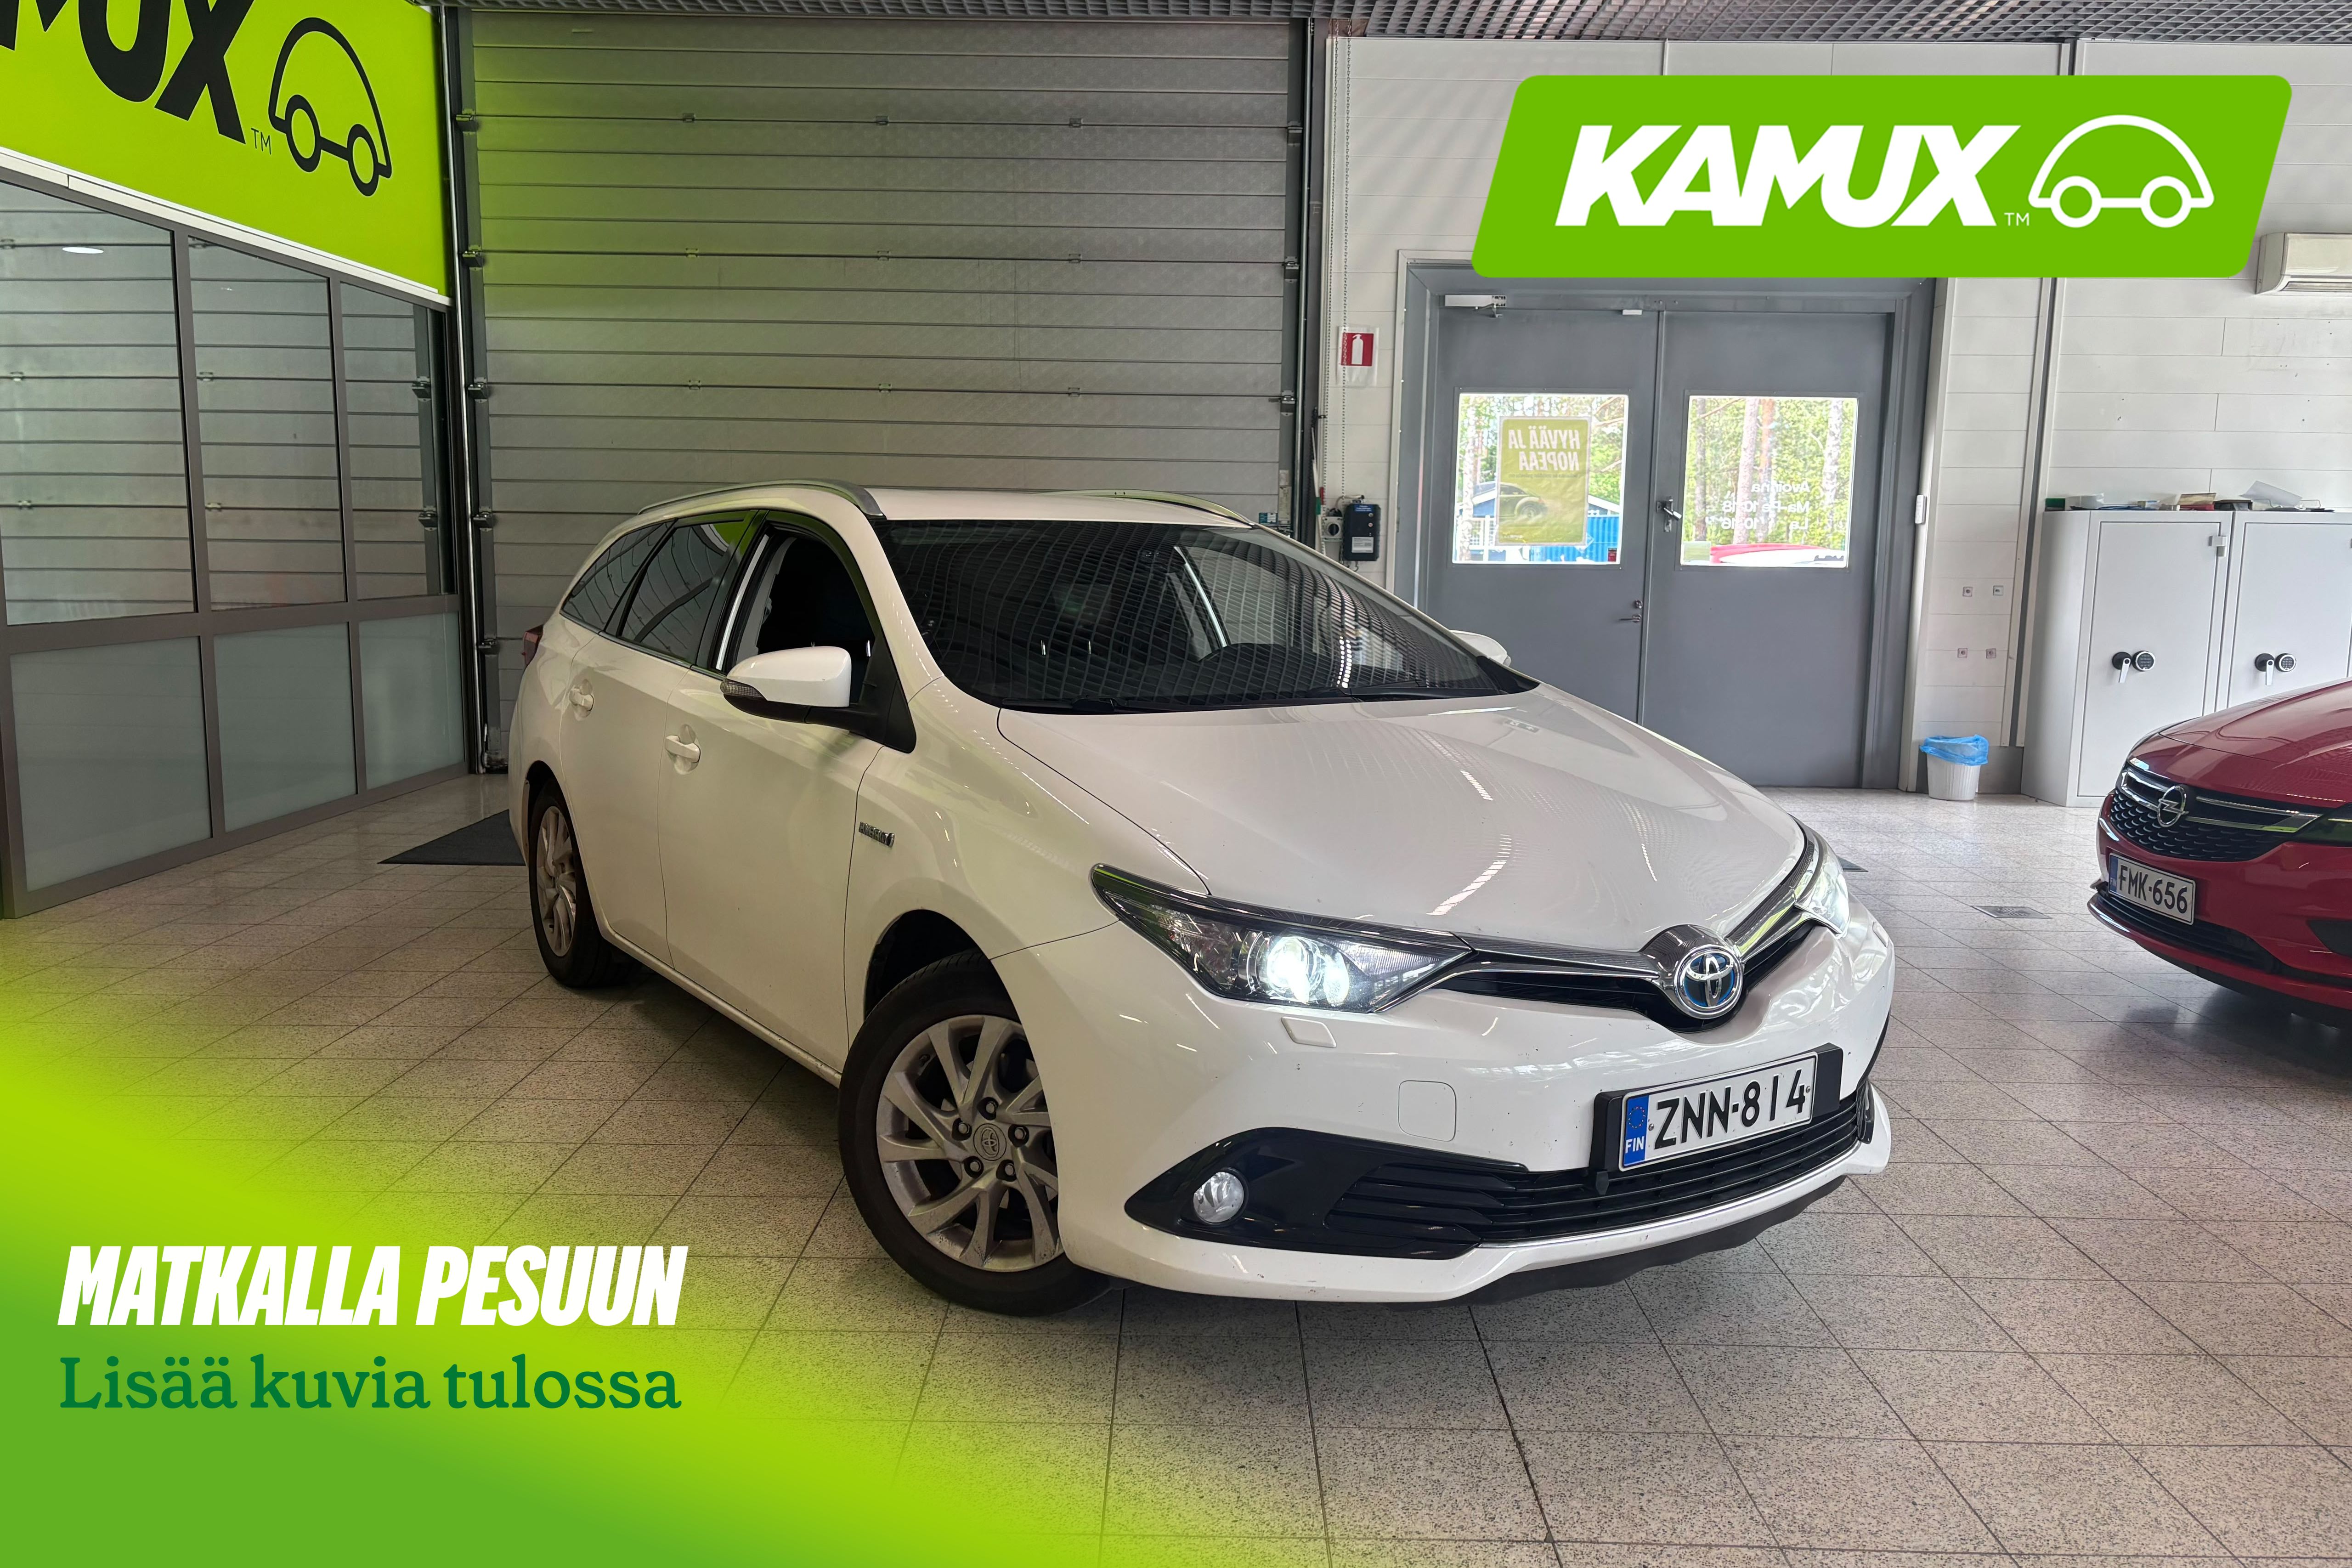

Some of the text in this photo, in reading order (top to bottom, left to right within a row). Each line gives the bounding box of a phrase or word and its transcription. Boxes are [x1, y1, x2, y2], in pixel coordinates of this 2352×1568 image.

[250, 127, 271, 155] TM
[2119, 865, 2188, 914] FMK-656
[1654, 1069, 1806, 1149] ZNN-814
[1625, 1136, 1645, 1154] FIN
